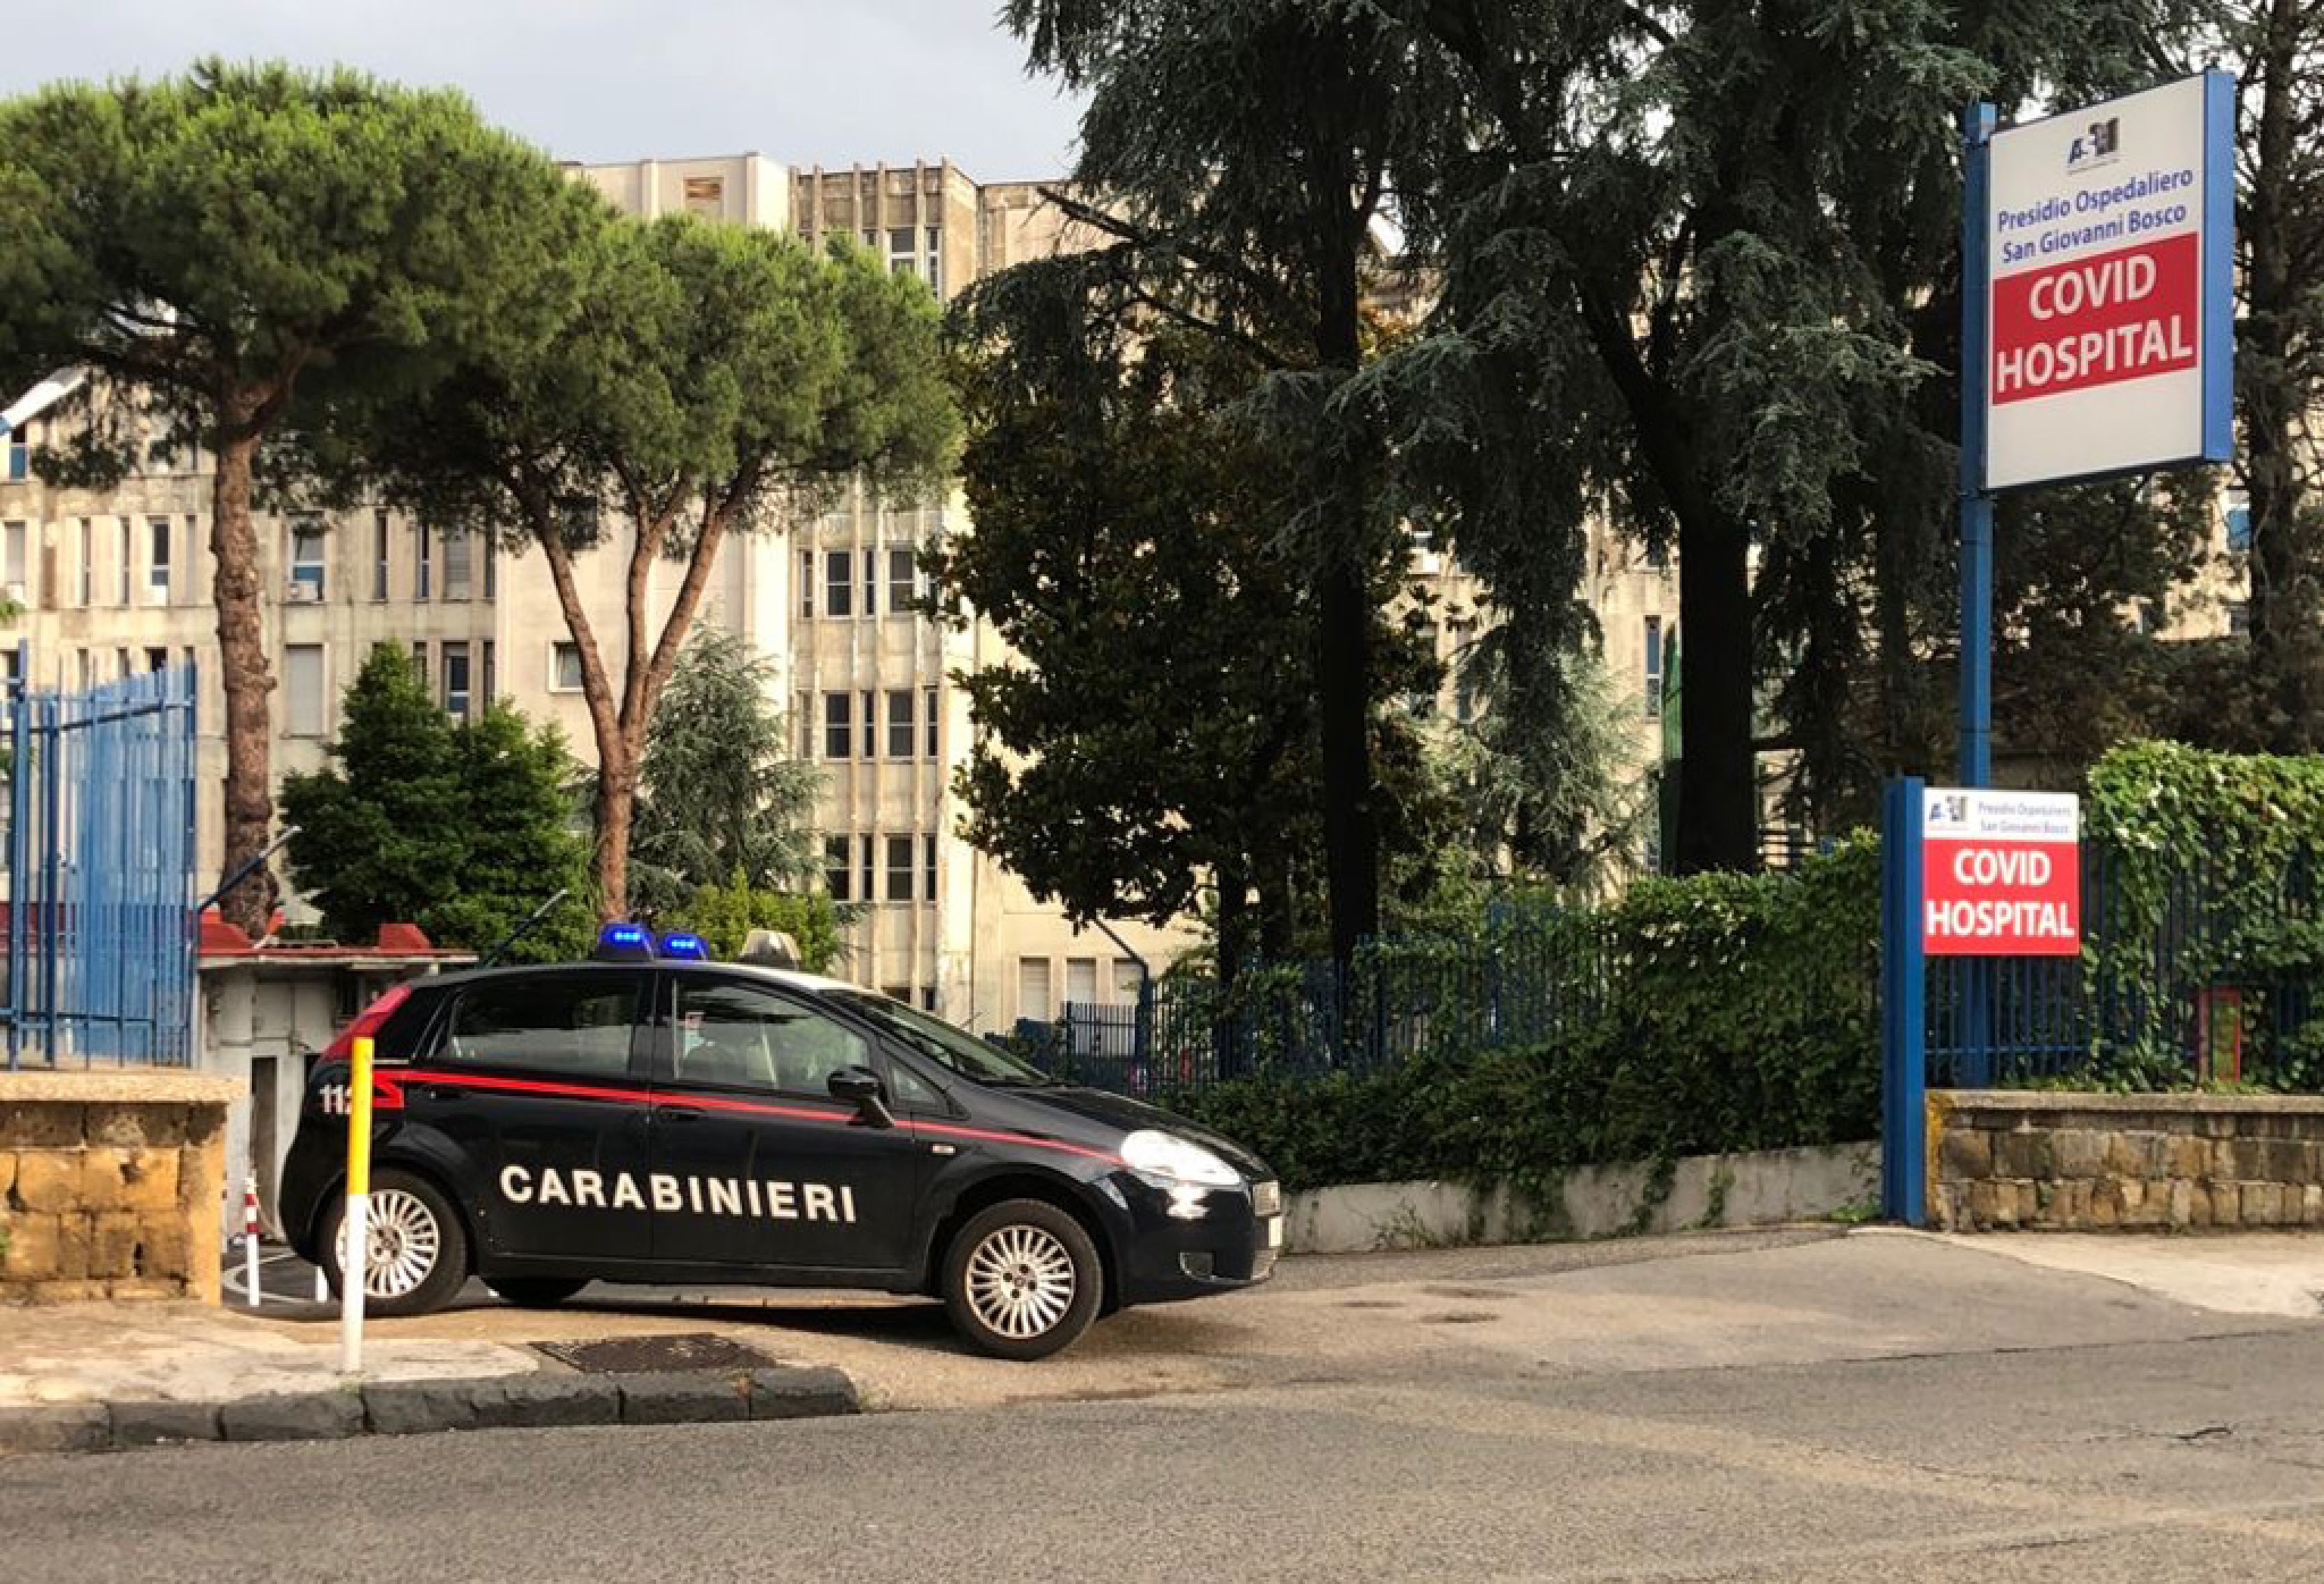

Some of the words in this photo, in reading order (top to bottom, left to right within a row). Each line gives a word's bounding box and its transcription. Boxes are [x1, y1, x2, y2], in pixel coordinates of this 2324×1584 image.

[1998, 197, 2071, 231] Presidio
[2077, 170, 2192, 213] Ospedaliero
[2003, 241, 2036, 263] San
[2040, 213, 2124, 253] Giovanni
[2129, 204, 2186, 232] Bosco
[2029, 253, 2157, 320] COVID
[1997, 315, 2192, 393] HOSPITAL
[1954, 849, 2052, 886] COVID
[1926, 900, 2074, 937] HOSPITAL
[499, 1164, 856, 1224] CARABINIERI
